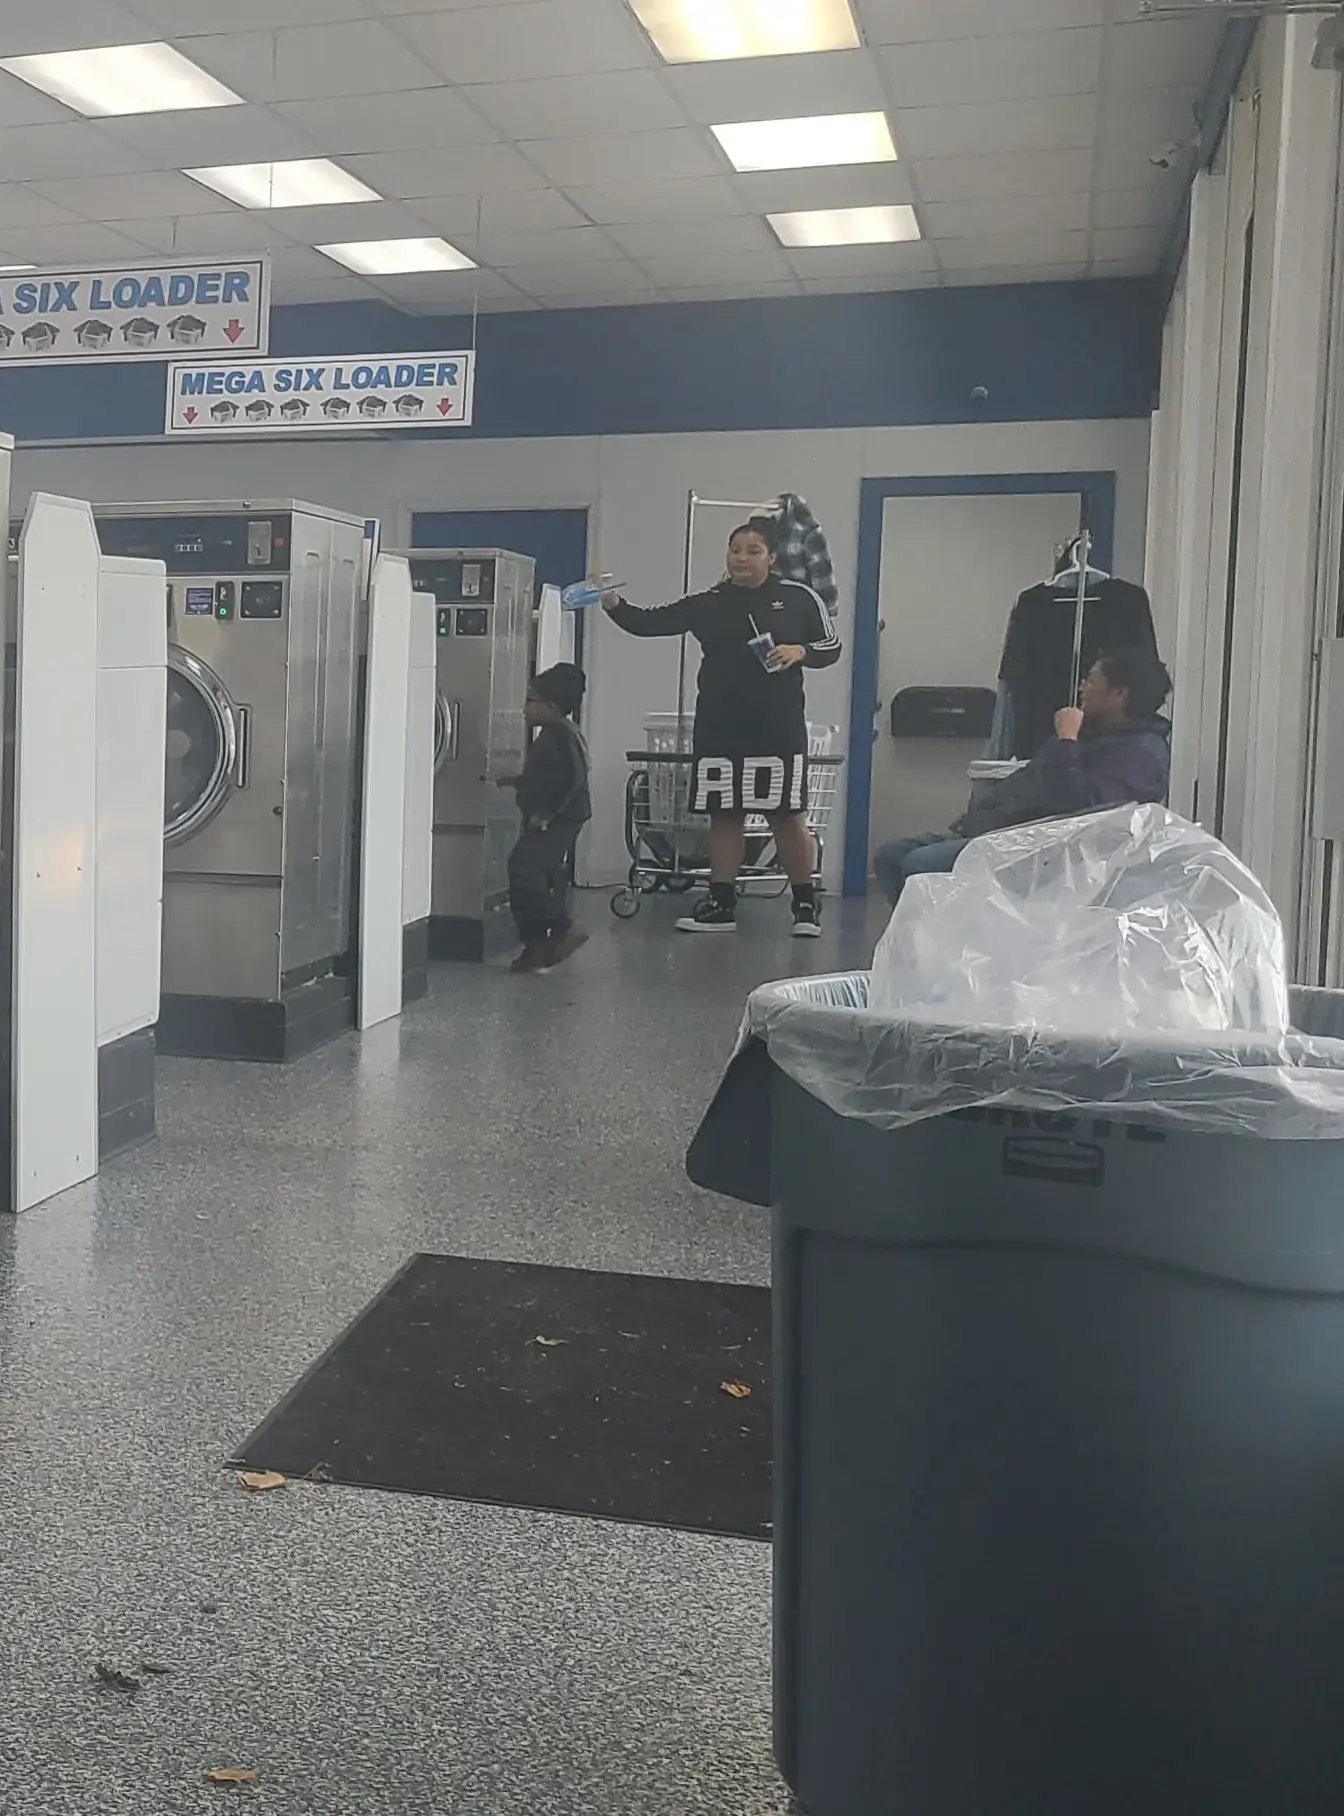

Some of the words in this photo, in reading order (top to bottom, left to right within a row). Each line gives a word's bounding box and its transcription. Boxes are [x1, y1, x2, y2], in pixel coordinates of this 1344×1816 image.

[12, 280, 80, 315] SIX
[89, 270, 251, 311] LOADER
[180, 369, 266, 396] MEGA
[273, 367, 327, 393] SIX
[332, 362, 459, 390] LOADER
[694, 753, 804, 810] ADI
